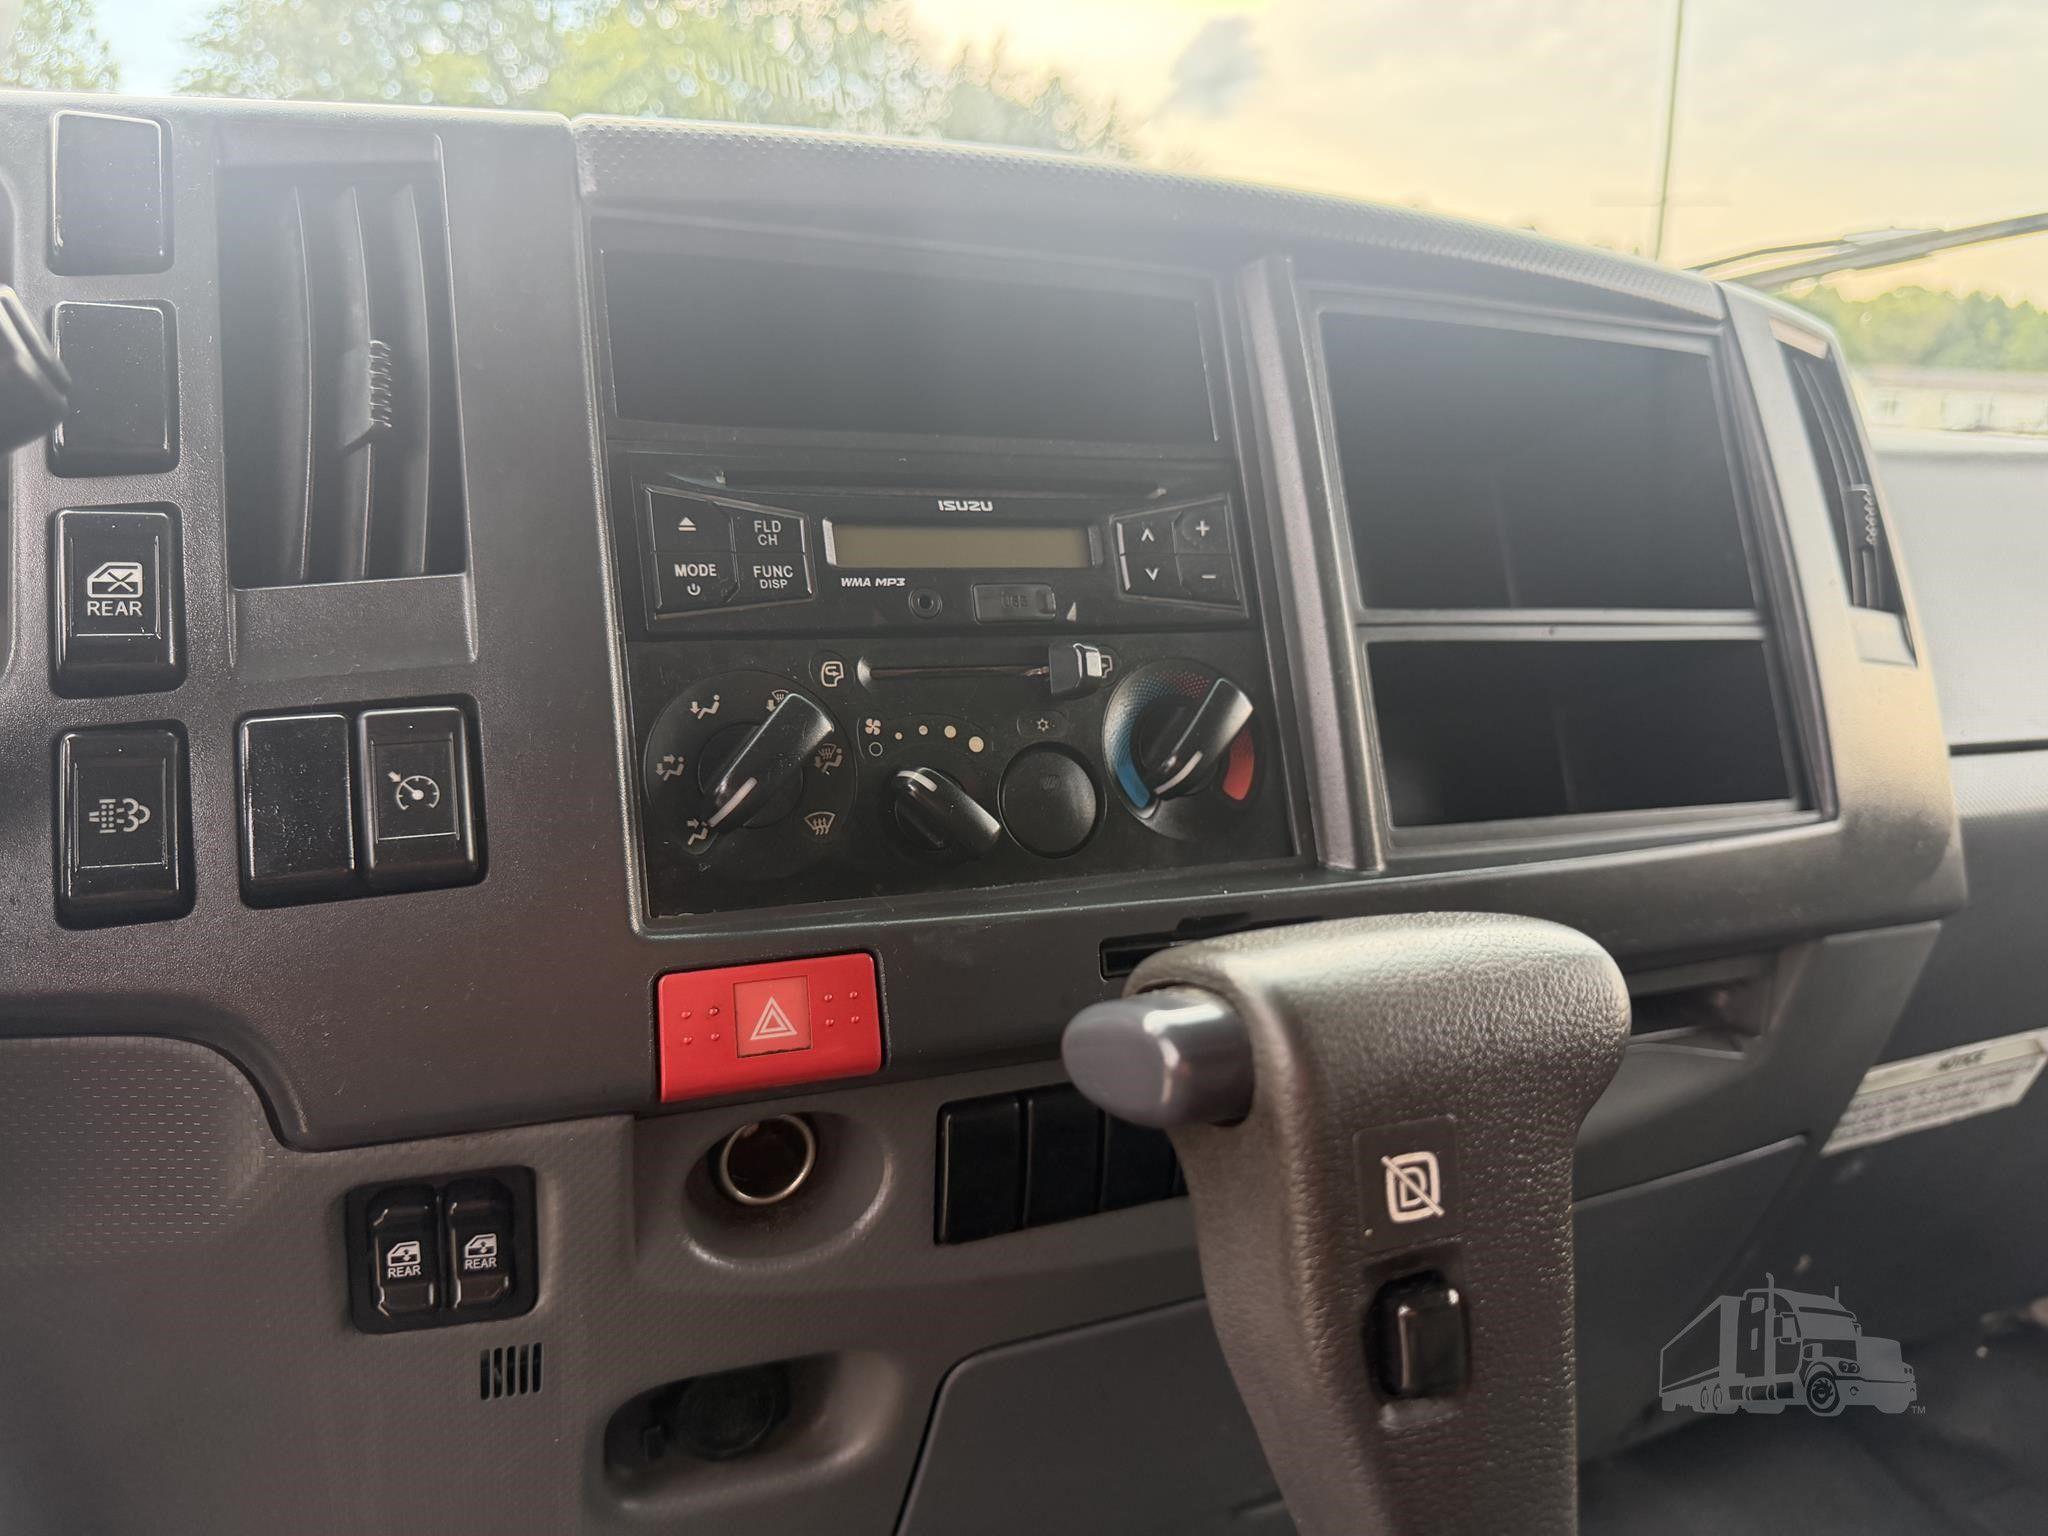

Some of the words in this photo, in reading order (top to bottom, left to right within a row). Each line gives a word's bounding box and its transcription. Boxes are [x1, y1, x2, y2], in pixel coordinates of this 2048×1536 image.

[938, 500, 994, 512] ISUZU
[753, 520, 782, 533] FLD
[757, 534, 779, 546] CH
[674, 563, 718, 577] MODE
[753, 565, 794, 578] FUNC
[760, 579, 788, 589] DISP
[840, 577, 872, 587] WMA
[875, 577, 907, 587] MP3
[86, 600, 143, 617] REAR
[463, 1257, 498, 1270] REAR
[387, 1265, 422, 1279] REAR
